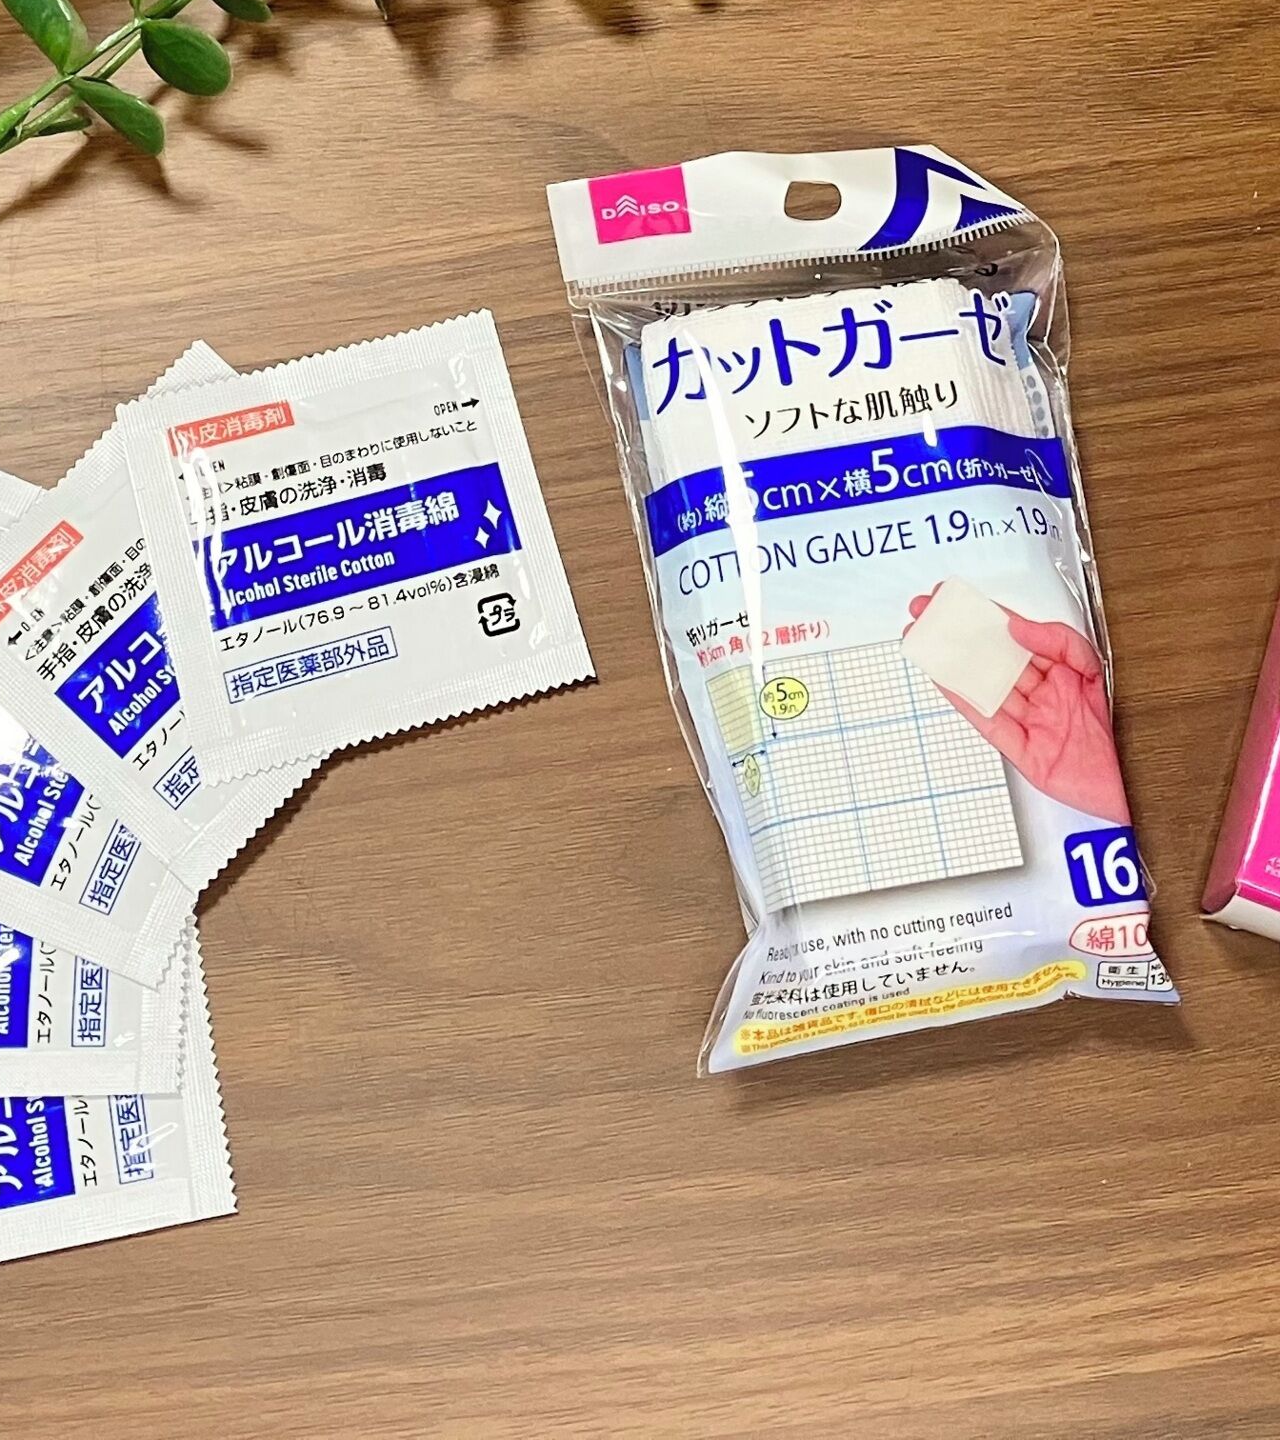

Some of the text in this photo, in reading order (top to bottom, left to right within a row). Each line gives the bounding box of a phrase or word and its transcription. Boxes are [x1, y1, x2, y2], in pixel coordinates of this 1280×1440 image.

[651, 291, 1013, 415] カットガーゼ
[433, 401, 459, 417] OPEN
[744, 380, 960, 439] ソフトな肌触り
[284, 564, 339, 593] Sterile
[340, 550, 396, 577] Cotton
[806, 520, 917, 565] GAUZE
[230, 633, 391, 699] 指定医薬部外品
[108, 678, 163, 736] Alcohol
[13, 800, 56, 867] Alcohol
[1070, 837, 1139, 900] 16
[833, 927, 866, 947] with
[870, 926, 889, 941] no
[893, 915, 945, 938] cutting
[950, 902, 1013, 928] required
[822, 998, 865, 1013] coating
[869, 994, 878, 1003] is
[881, 987, 910, 1000] used
[24, 1116, 55, 1188] Alcohol
